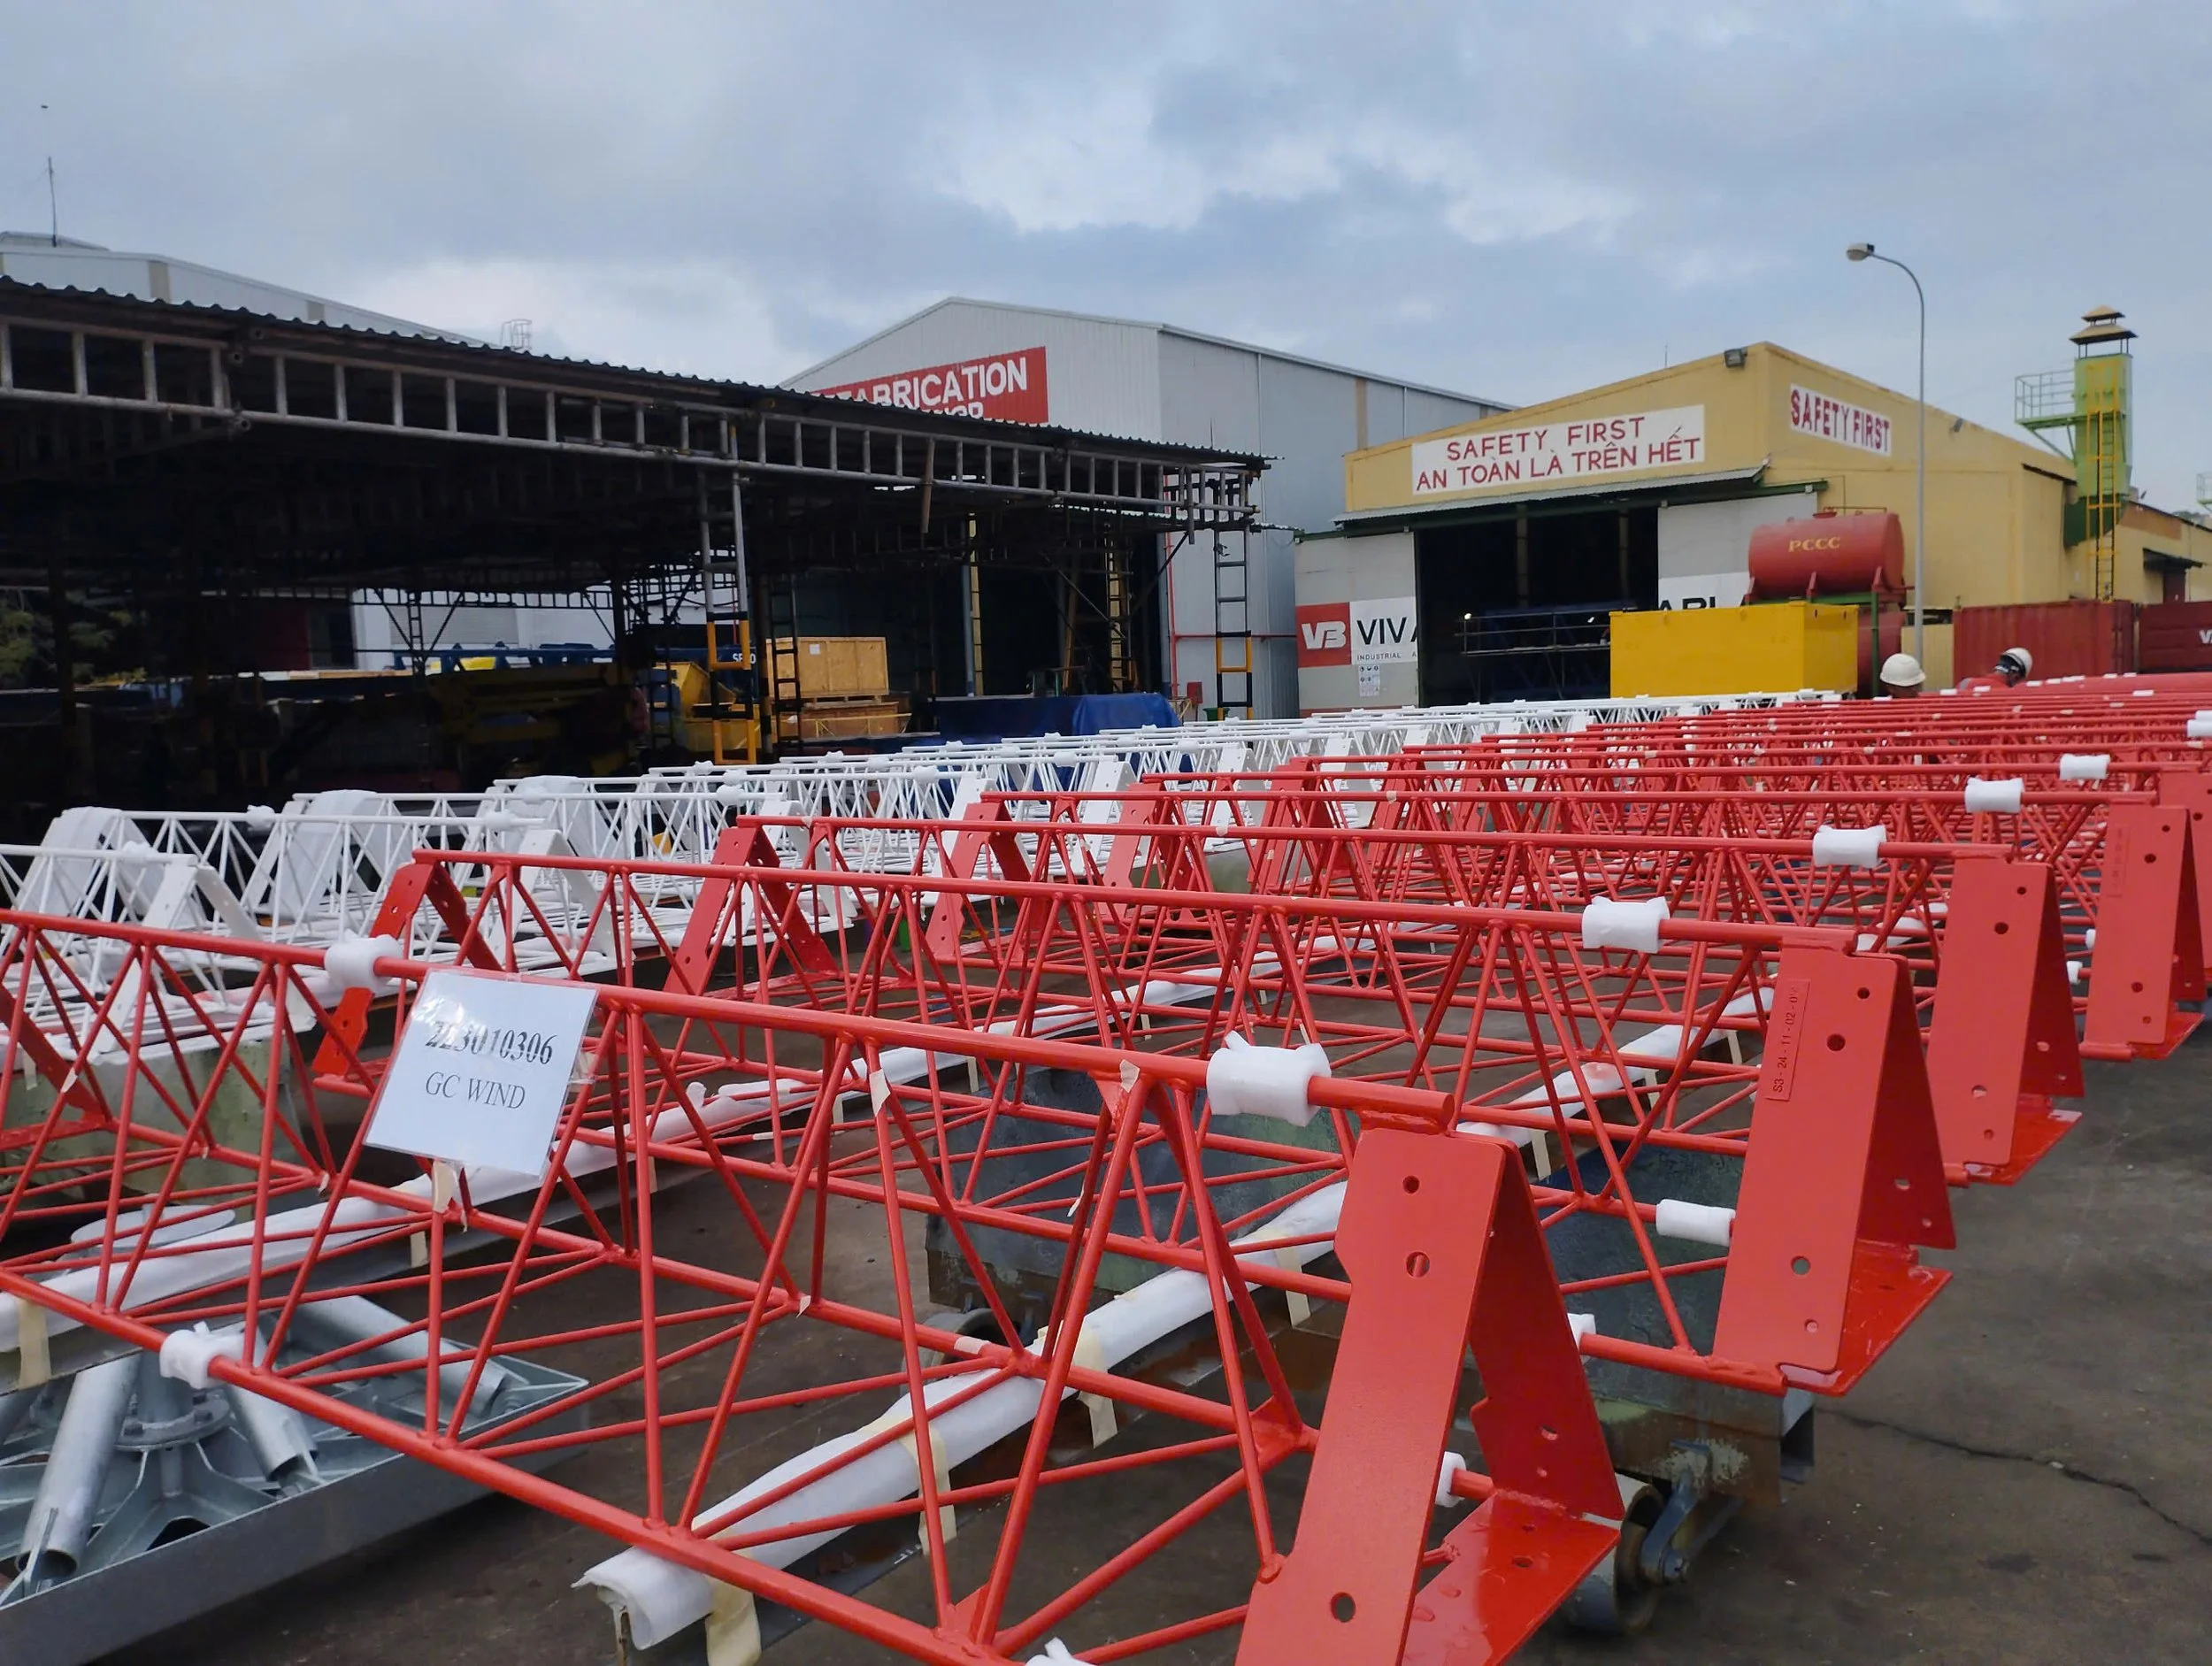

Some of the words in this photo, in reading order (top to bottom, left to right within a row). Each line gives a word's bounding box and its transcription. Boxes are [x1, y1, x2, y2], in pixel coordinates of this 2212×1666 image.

[1447, 429, 1548, 461] SAFETY
[1568, 417, 1645, 446] FIRST
[1791, 389, 1850, 441] SAFETY
[1854, 410, 1890, 451] FIRST
[1417, 469, 1448, 491] AN
[1457, 456, 1520, 486] TOÀN
[1530, 449, 1563, 478] LÀ
[1572, 441, 1637, 472] TRÊN
[1788, 537, 1840, 552] PCCC
[1302, 621, 1347, 650] VB
[1356, 652, 1402, 661] INDUSTRIAL
[426, 1071, 460, 1099] GC
[466, 1078, 526, 1109] WIND
